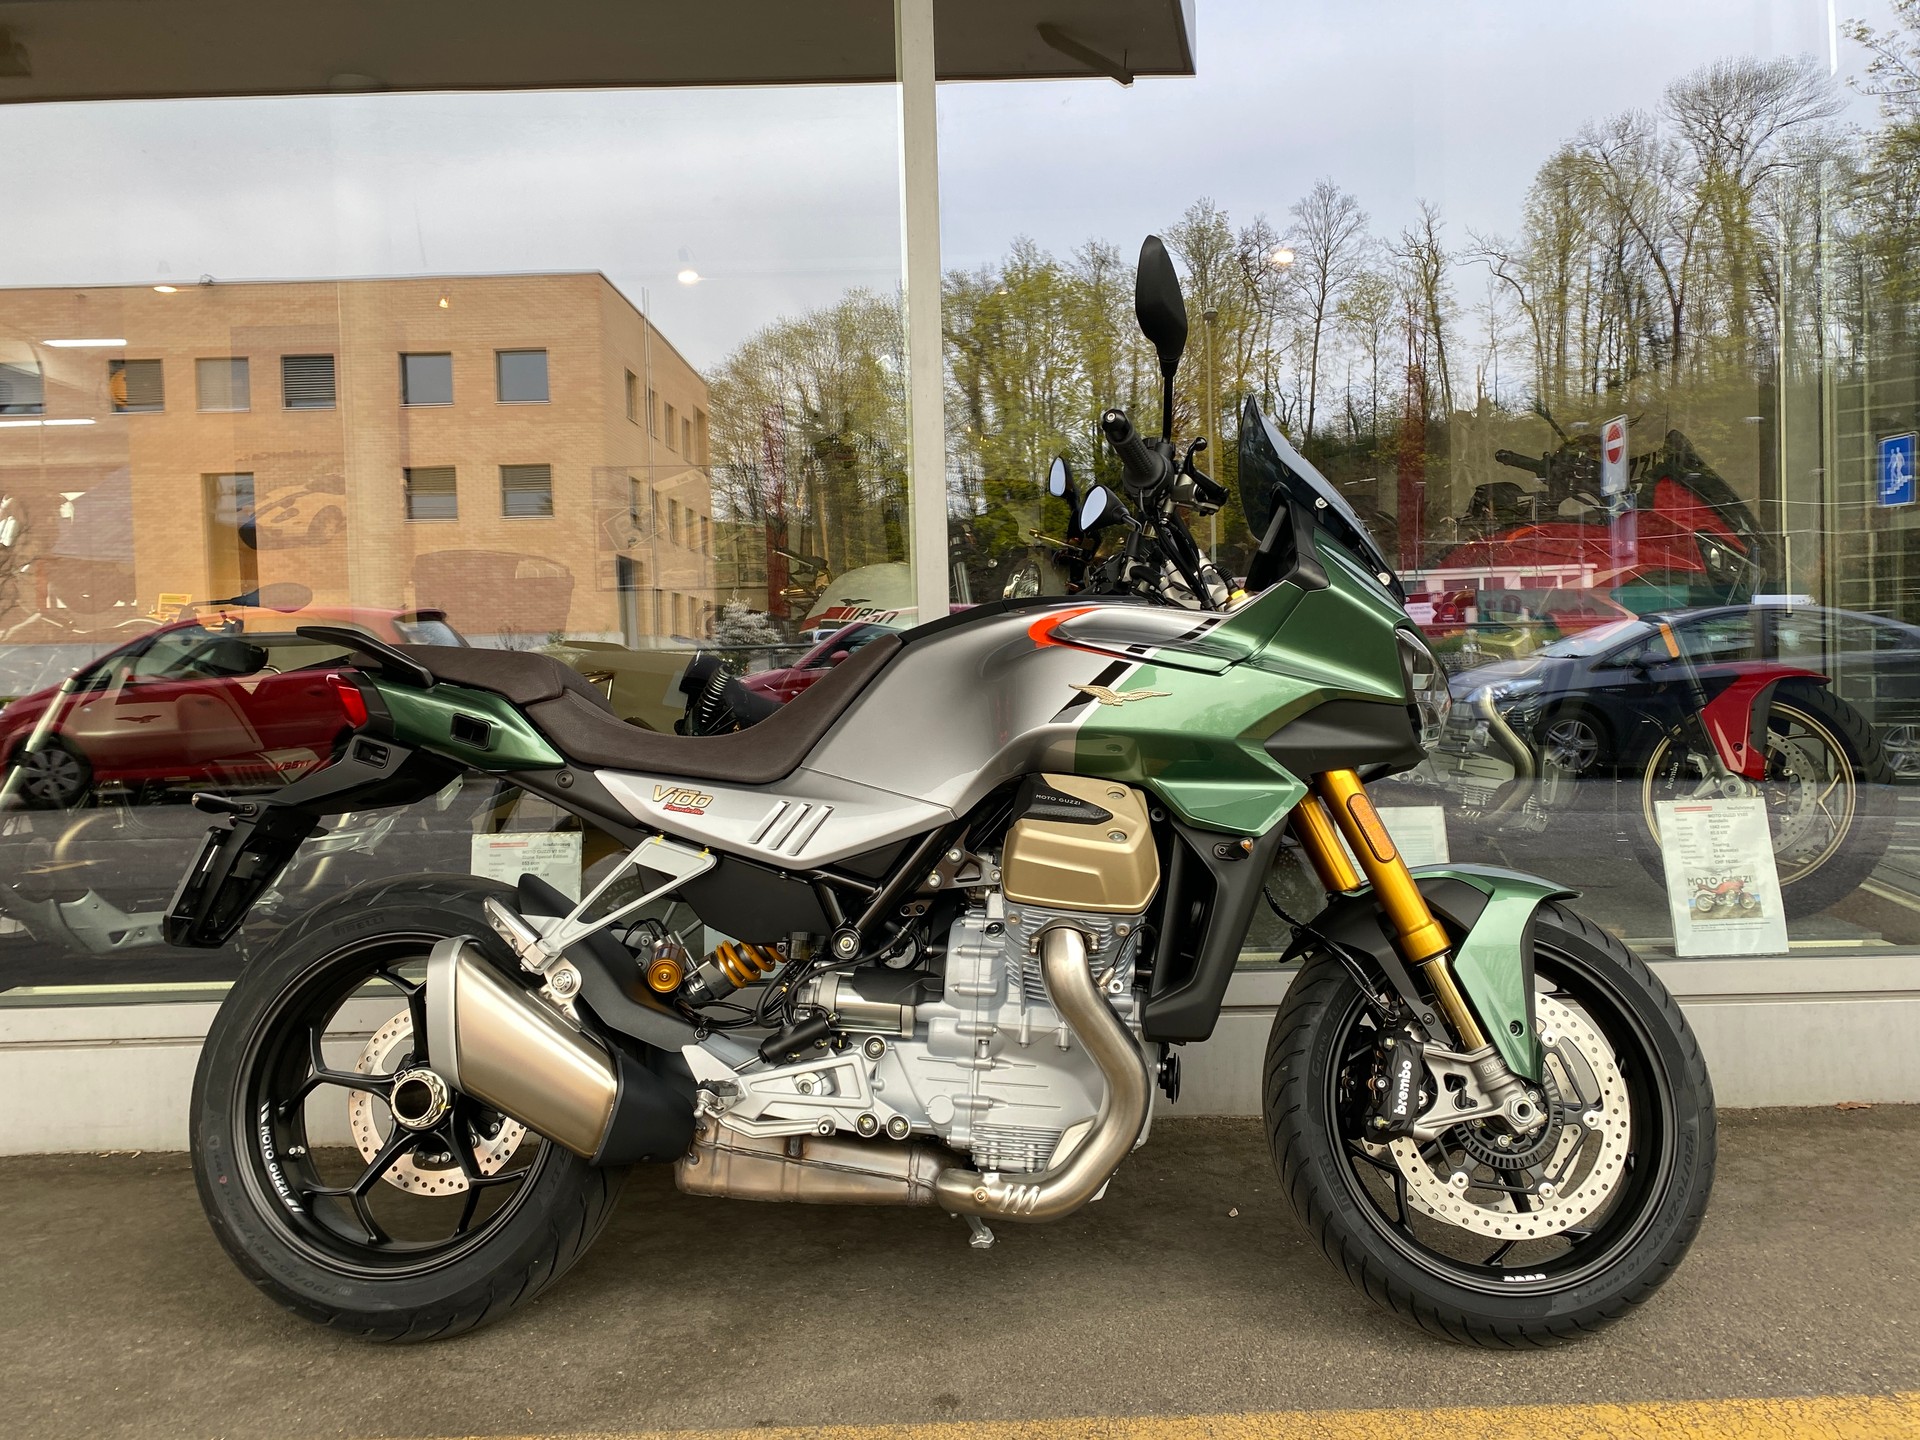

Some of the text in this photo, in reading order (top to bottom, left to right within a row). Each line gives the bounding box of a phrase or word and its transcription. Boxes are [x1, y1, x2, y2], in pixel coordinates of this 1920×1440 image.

[1665, 762, 1679, 789] brembo
[653, 785, 714, 809] V100
[1058, 798, 1081, 806] GUZZI
[1687, 874, 1753, 887] MOTO GZI
[1393, 1060, 1412, 1115] brembo
[261, 1126, 291, 1197] MOTO GUZZI
